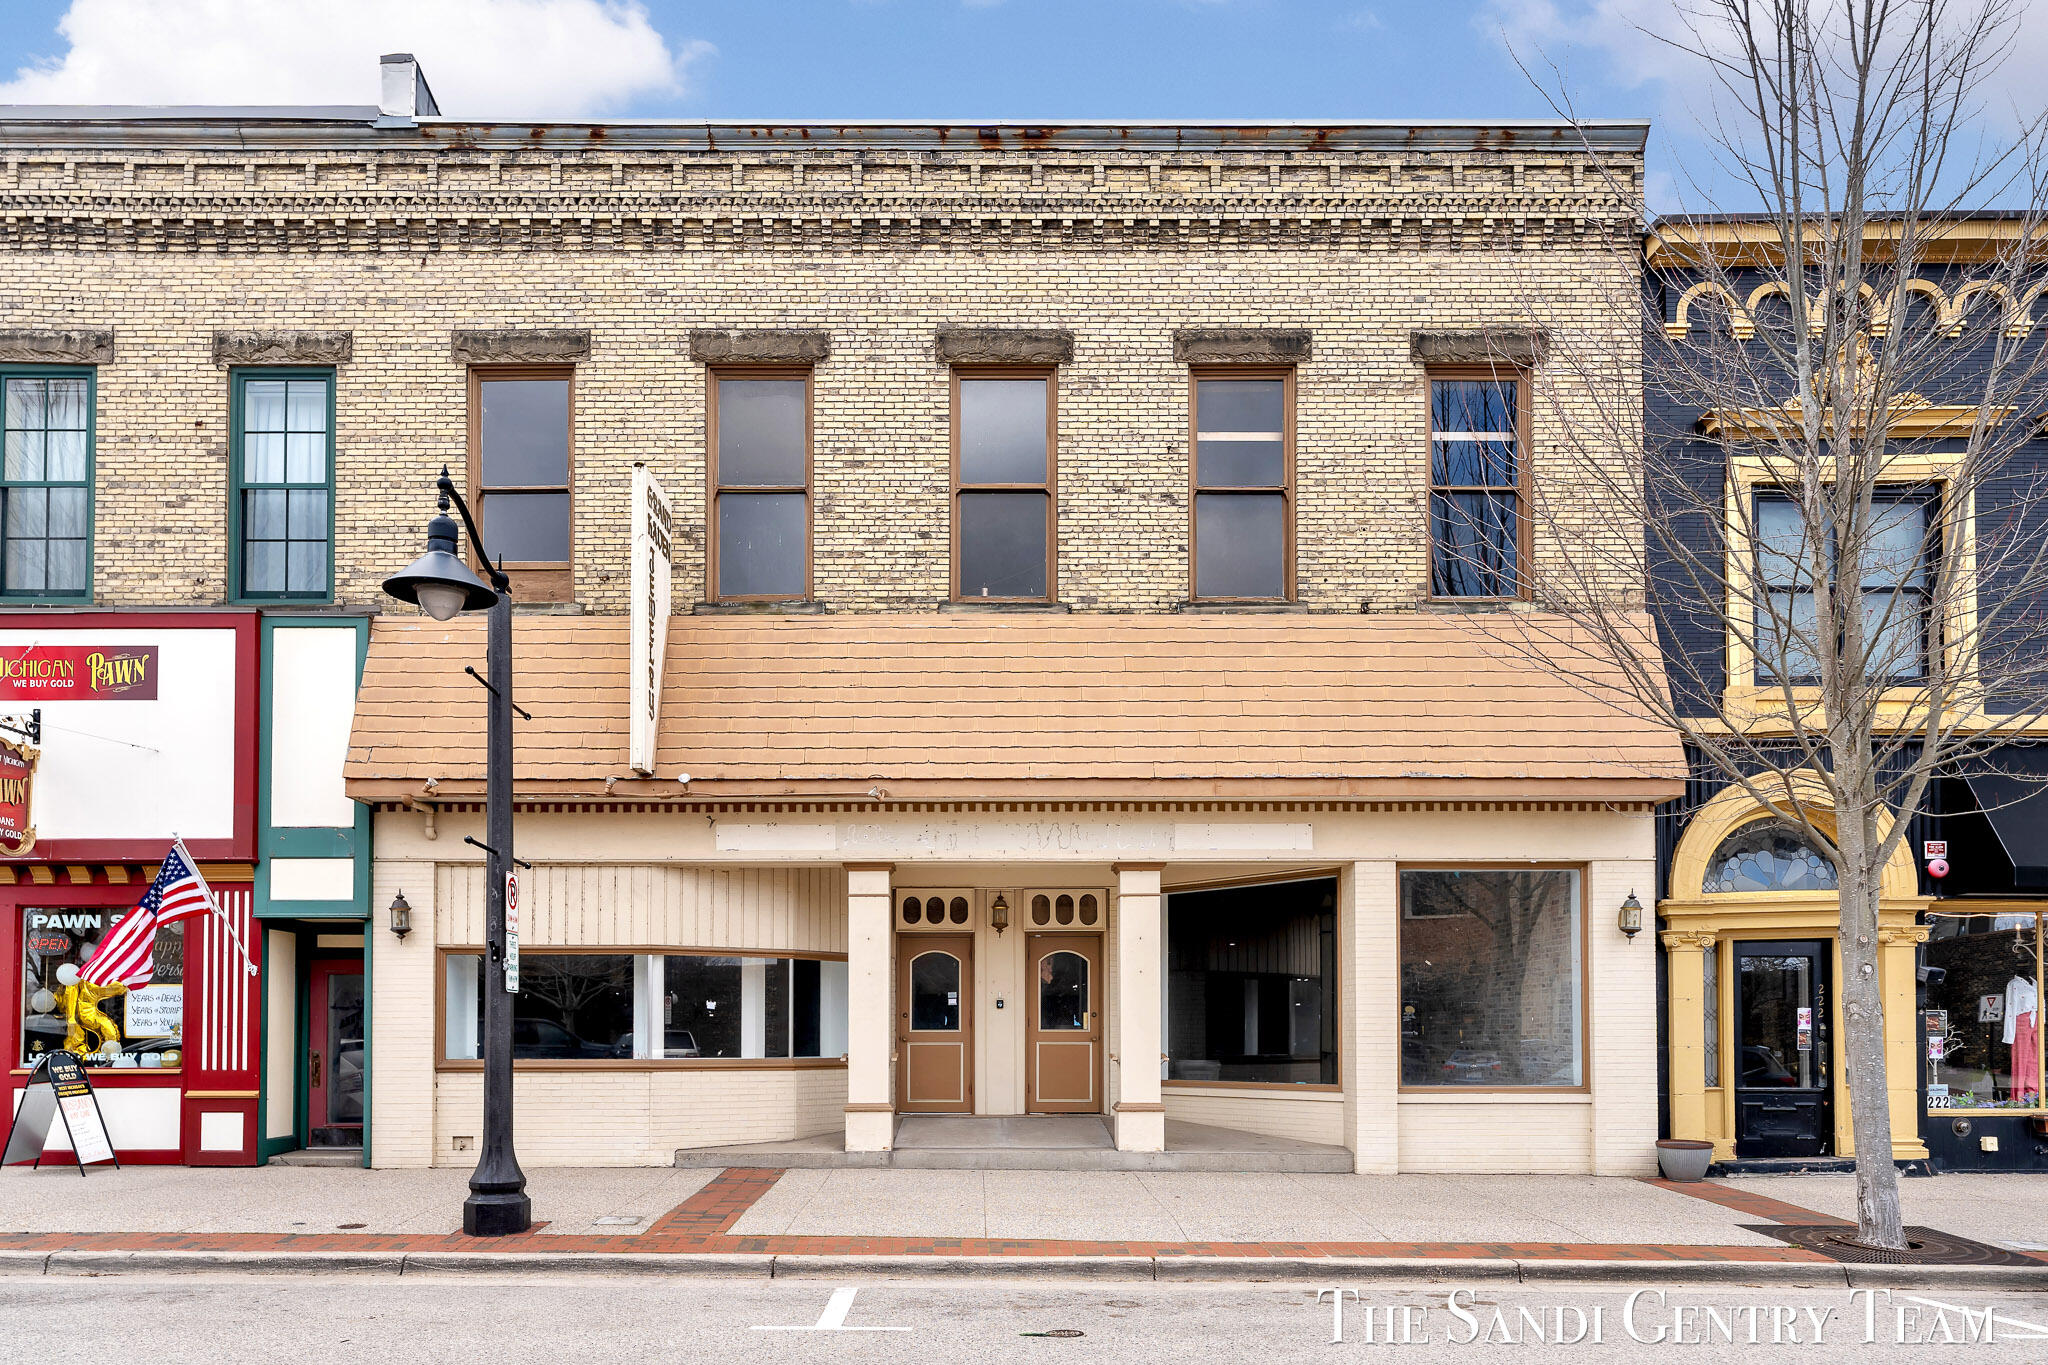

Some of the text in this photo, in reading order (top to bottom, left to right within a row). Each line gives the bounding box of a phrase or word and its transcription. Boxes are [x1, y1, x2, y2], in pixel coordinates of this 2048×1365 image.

[86, 652, 150, 692] PAWN
[12, 679, 75, 688] WE BUY GOLD
[5, 829, 22, 840] GOLD
[32, 914, 101, 929] PAWN
[28, 938, 69, 950] OPEN
[86, 1053, 107, 1062] WE
[110, 1052, 139, 1062] BUY
[141, 1052, 179, 1062] GOLD
[51, 1064, 78, 1074] WE BUY
[58, 1072, 77, 1081] GOLD
[1928, 1096, 1949, 1109] 222
